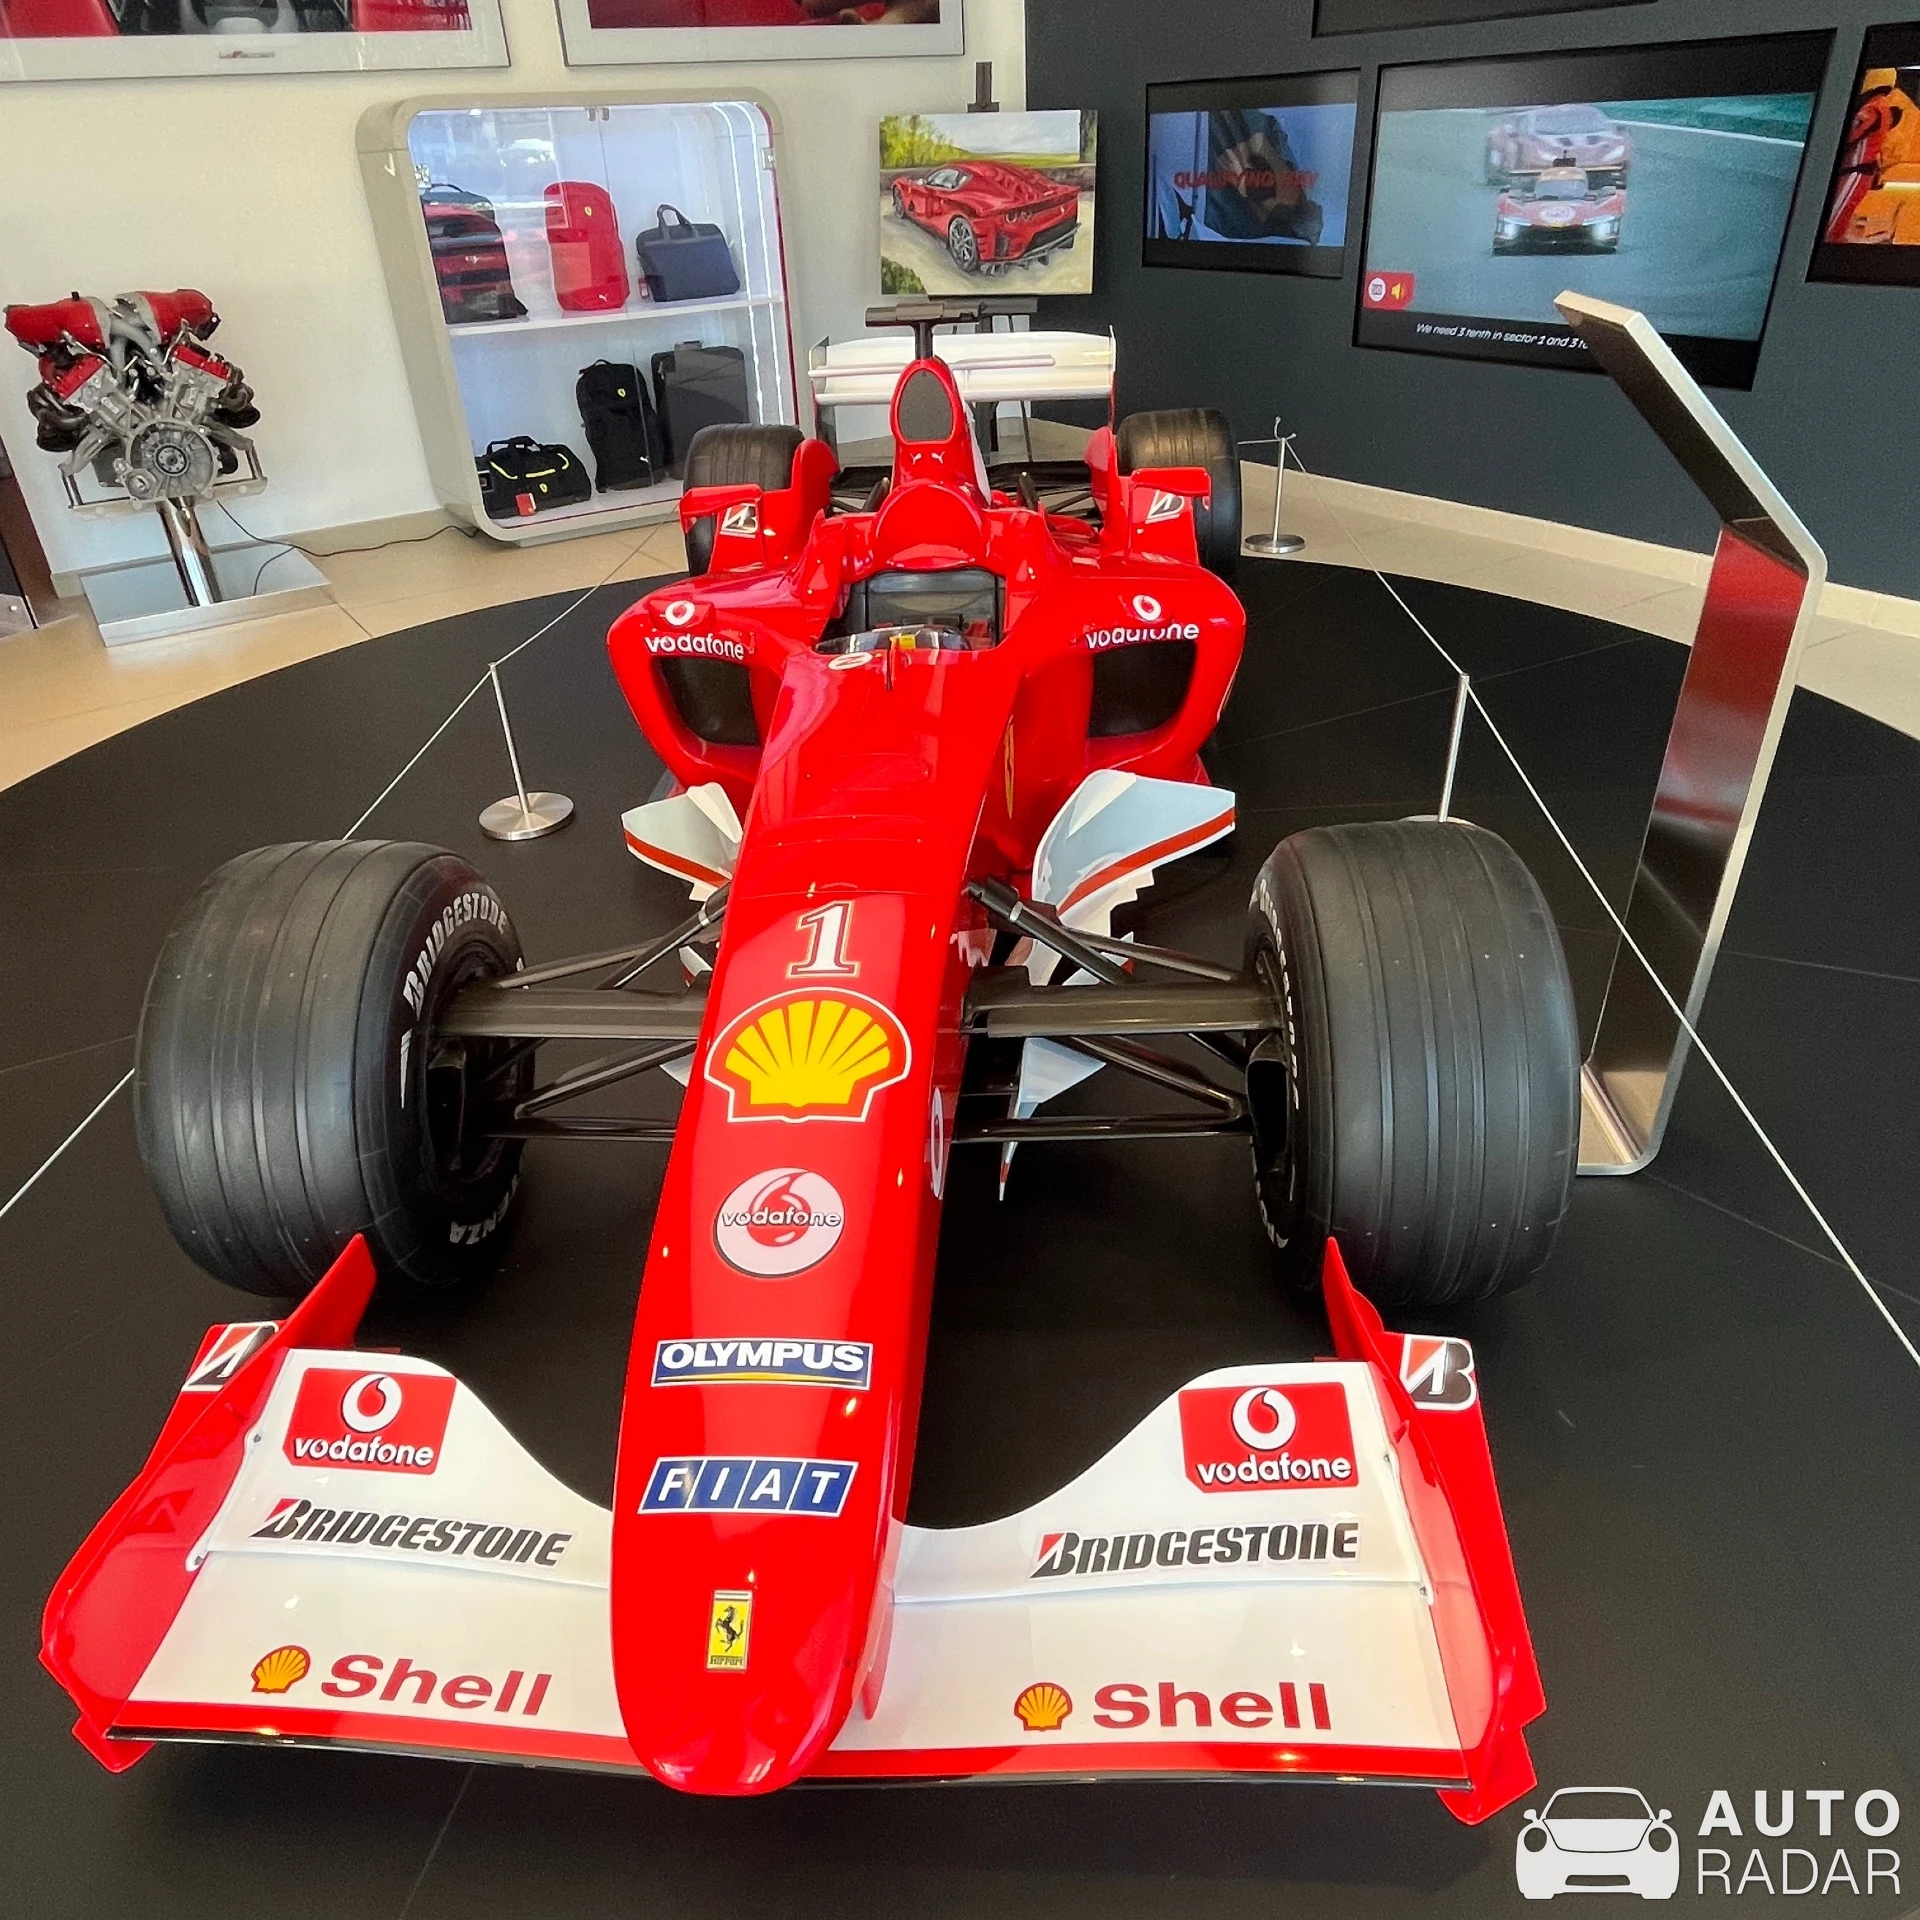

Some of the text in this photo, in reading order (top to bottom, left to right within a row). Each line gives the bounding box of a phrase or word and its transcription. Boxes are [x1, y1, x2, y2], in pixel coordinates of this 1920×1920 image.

[1416, 323, 1432, 333] We
[1433, 325, 1458, 336] need
[1457, 326, 1466, 337] 3
[1465, 328, 1492, 340] tenth
[1492, 330, 1503, 340] in
[1503, 332, 1537, 343] sector
[1537, 335, 1546, 345] 1
[1546, 336, 1570, 347] and
[1568, 337, 1579, 348] 3
[644, 633, 745, 660] vodafone
[403, 892, 508, 1021] BRIDGESTONE
[785, 900, 861, 979] 1
[722, 1206, 842, 1227] vodafone
[661, 1342, 864, 1373] OLYMPUS
[294, 1434, 434, 1467] vodafone
[1196, 1451, 1352, 1485] vodafone
[657, 1467, 840, 1504] FIAT
[249, 1498, 572, 1567] BRIDGESTONE
[1030, 1522, 1359, 1579] BRIDGESTONE
[709, 1655, 743, 1666] Ferrari
[321, 1654, 552, 1716] Shell
[1093, 1682, 1332, 1731] Shell
